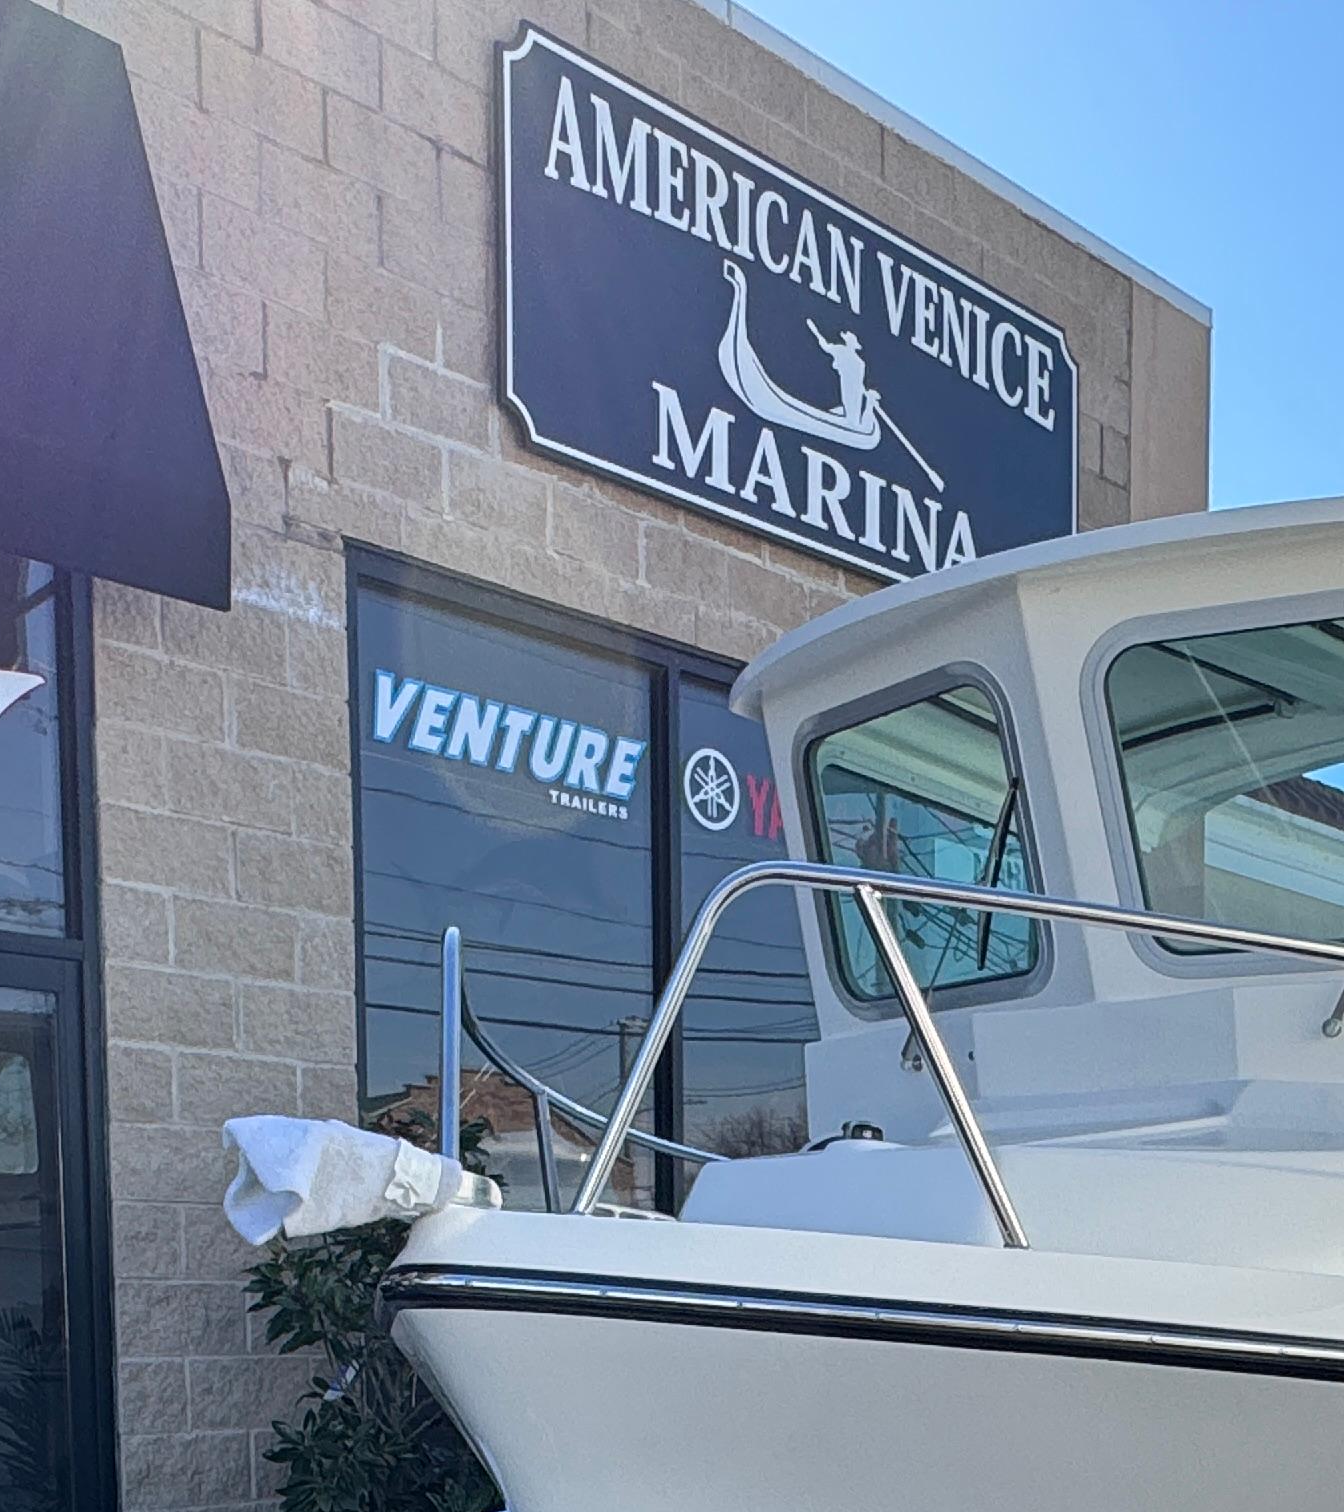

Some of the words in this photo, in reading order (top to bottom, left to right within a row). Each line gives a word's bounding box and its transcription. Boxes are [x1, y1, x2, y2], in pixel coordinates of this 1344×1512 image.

[544, 76, 864, 314] AMERICAN
[876, 249, 1055, 431] VENICE
[652, 380, 976, 574] MARINA
[373, 669, 646, 800] VENTURE
[548, 789, 629, 820] TRAILERS
